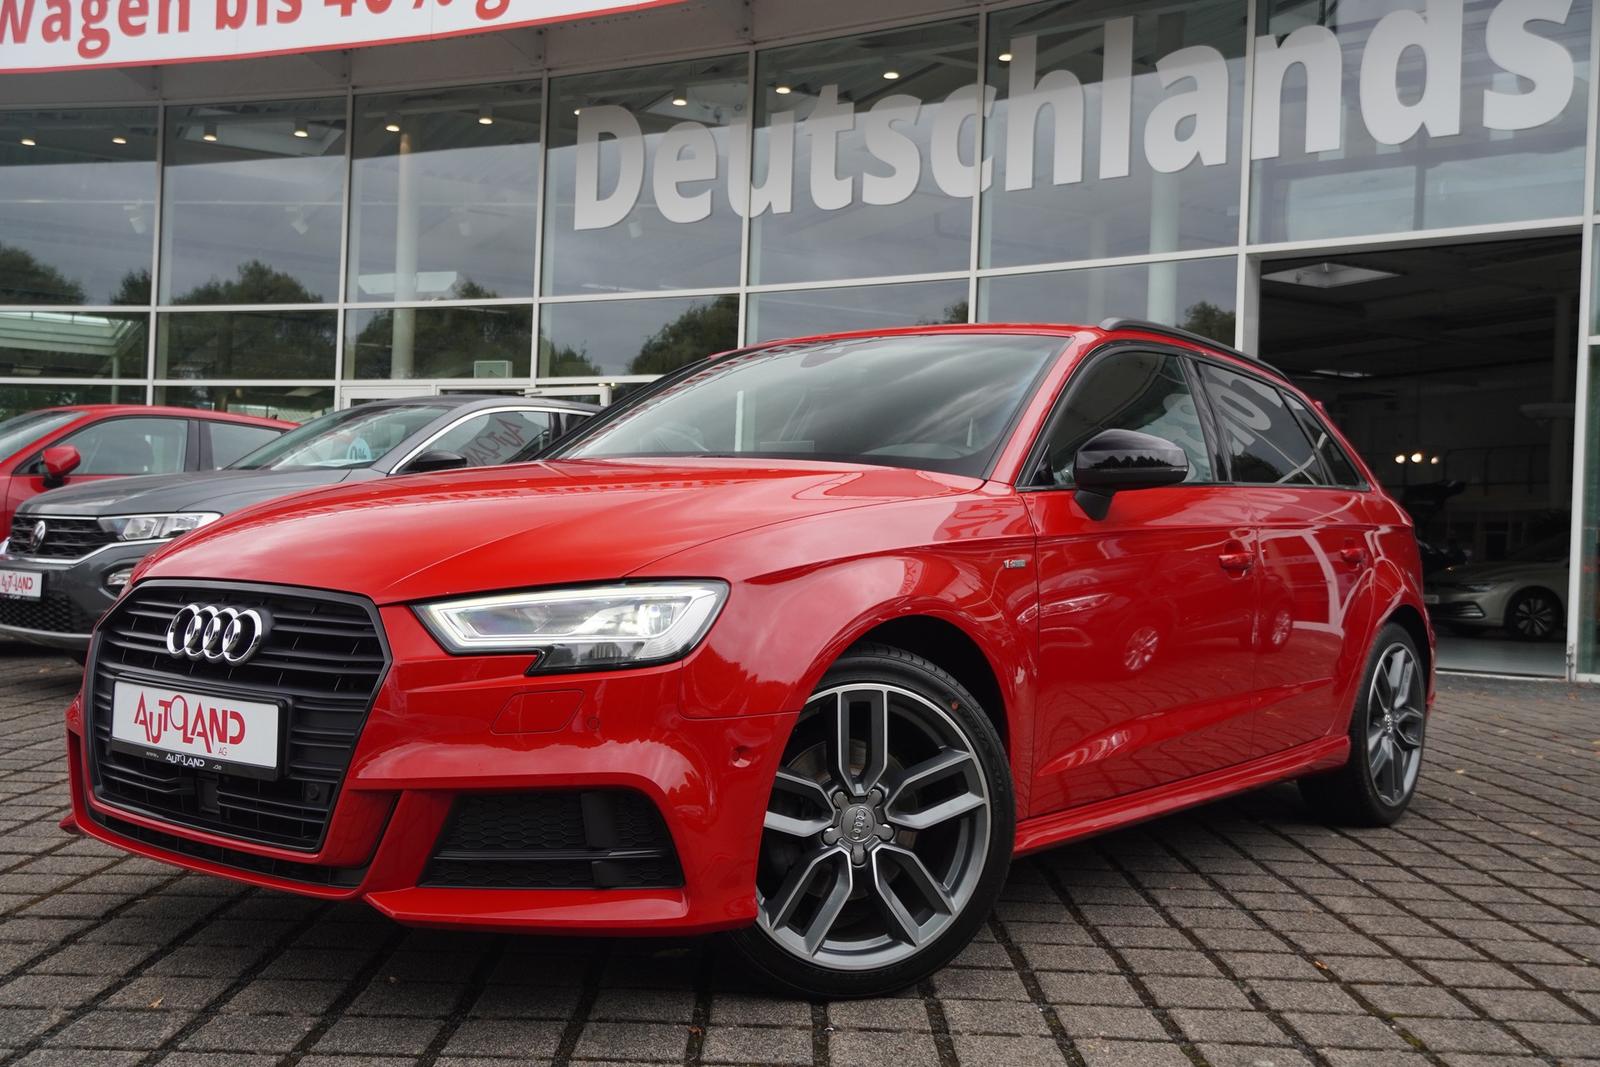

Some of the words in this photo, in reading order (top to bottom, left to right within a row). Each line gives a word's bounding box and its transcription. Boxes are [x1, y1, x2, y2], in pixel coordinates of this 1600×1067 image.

[574, 0, 1574, 230] Deutschlands
[134, 691, 246, 753] AUTOLAND
[165, 753, 205, 768] AUTOLAND
